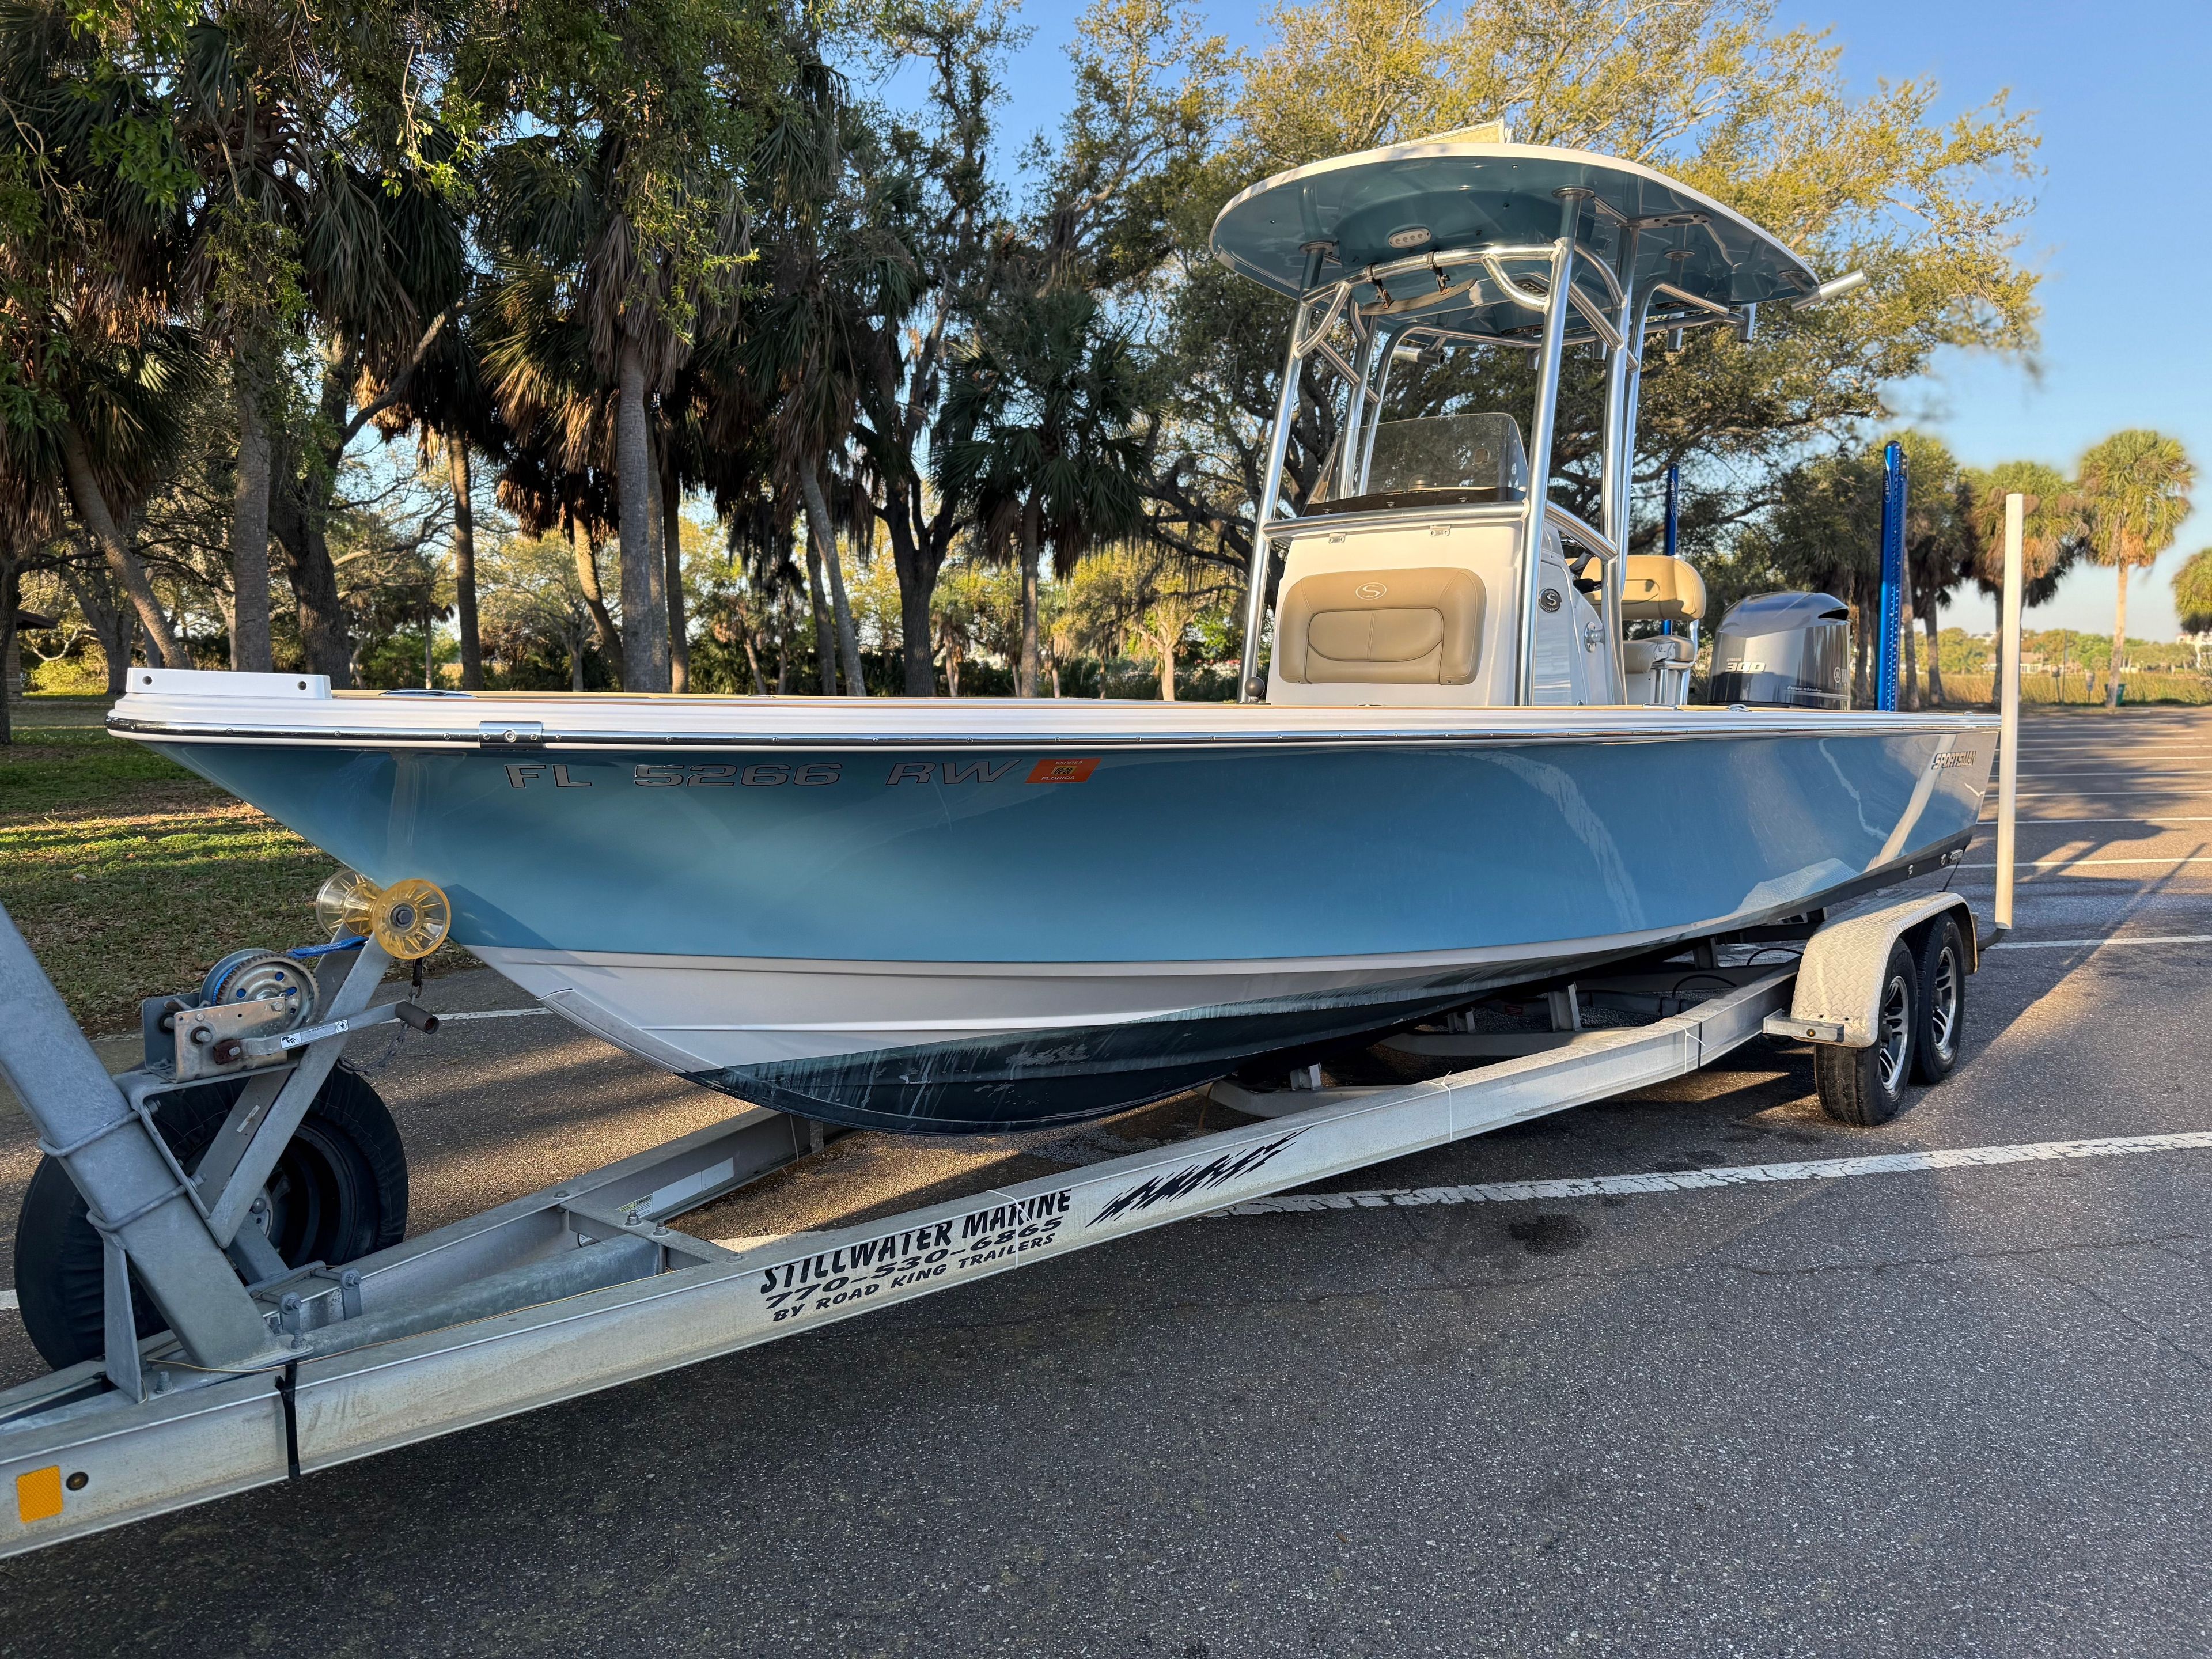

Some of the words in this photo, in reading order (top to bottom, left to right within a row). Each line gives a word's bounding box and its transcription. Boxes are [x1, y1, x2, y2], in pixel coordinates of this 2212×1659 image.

[1725, 662, 1766, 672] 300
[505, 764, 592, 788] FL
[634, 763, 843, 787] 5266
[885, 759, 1022, 786] RW
[760, 1220, 953, 1294] STILLWATER
[962, 1189, 1071, 1238] MARINE
[766, 1216, 1063, 1309] 770-530-6865
[773, 1304, 805, 1321] BY
[816, 1284, 880, 1310] ROAD
[891, 1264, 947, 1288] KING
[959, 1233, 1055, 1268] TRAILERS
